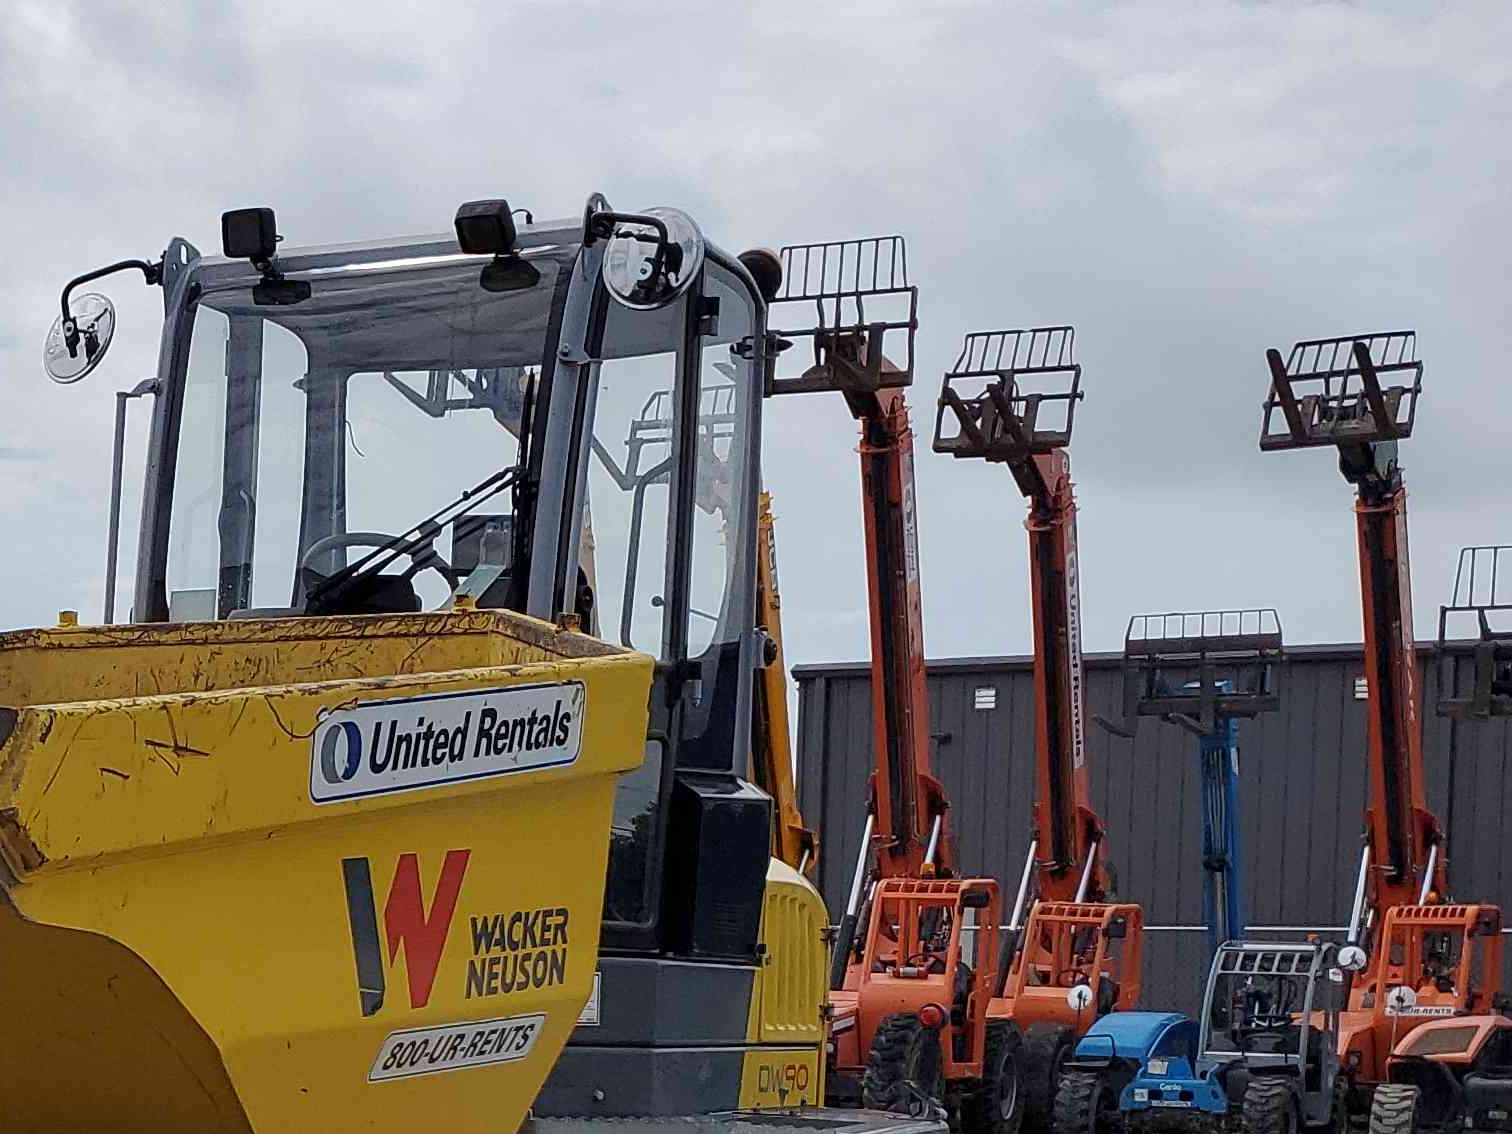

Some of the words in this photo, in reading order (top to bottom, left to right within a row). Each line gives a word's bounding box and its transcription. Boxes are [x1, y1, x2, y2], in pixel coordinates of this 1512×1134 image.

[369, 711, 471, 774] United
[474, 699, 572, 758] Rentals
[469, 907, 569, 955] WACKER
[465, 948, 568, 999] NEUSON
[381, 1024, 536, 1071] 800-UR-RENTS
[759, 1064, 809, 1093] DW90
